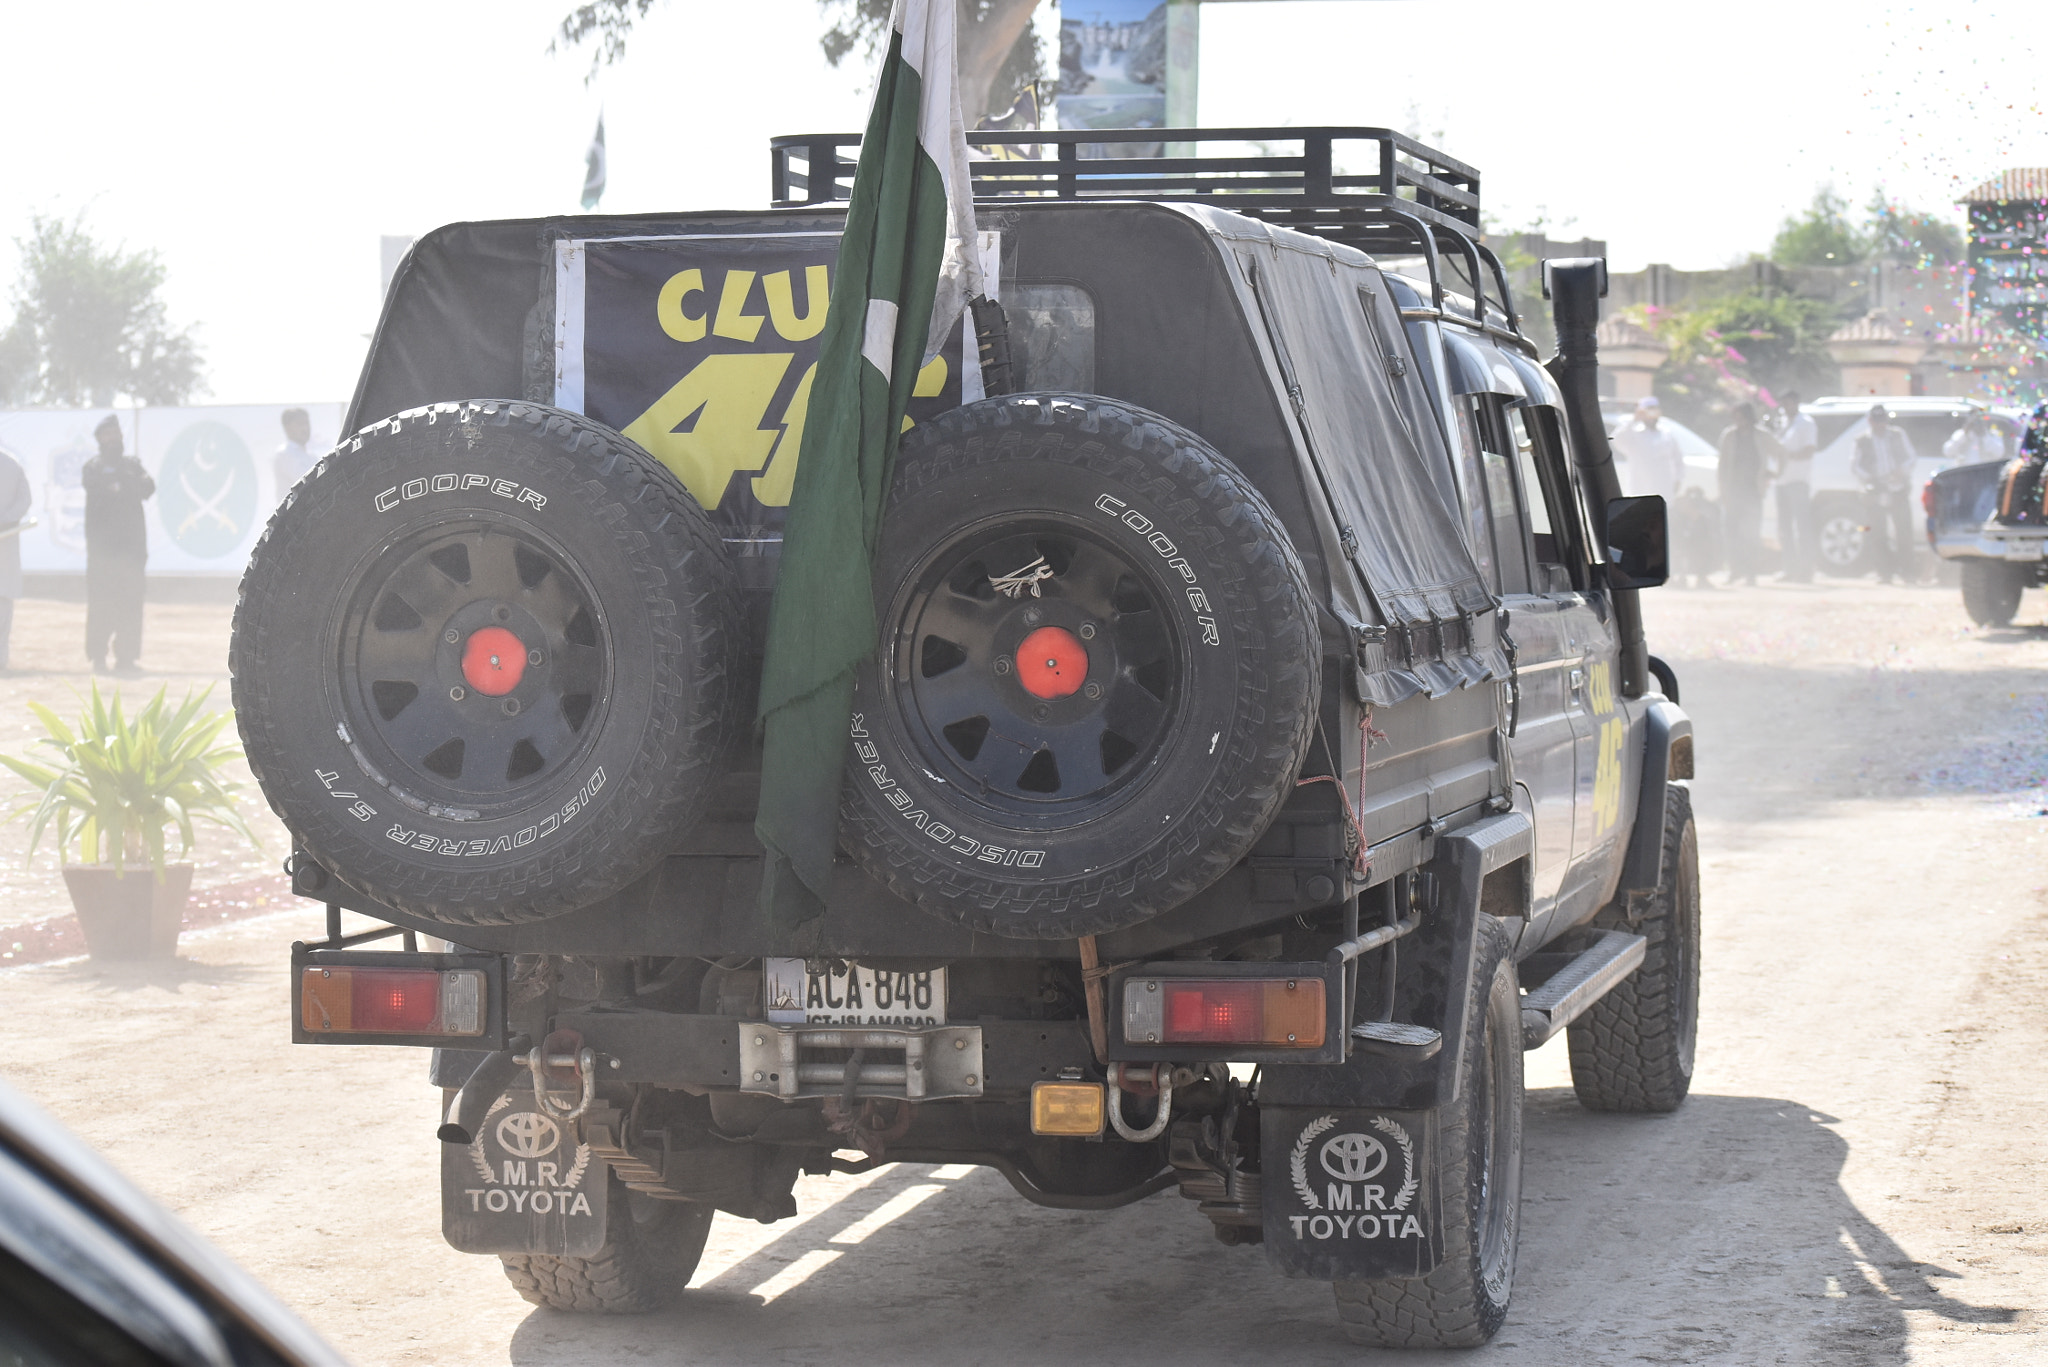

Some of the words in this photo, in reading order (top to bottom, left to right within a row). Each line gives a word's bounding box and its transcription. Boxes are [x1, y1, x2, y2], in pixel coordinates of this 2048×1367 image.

[657, 264, 830, 343] CLU
[374, 473, 547, 513] COOPER
[1094, 493, 1220, 646] COOPER
[314, 767, 378, 822] S/T
[386, 766, 607, 857] DISCOVERER
[850, 712, 1046, 868] DISCOVERER
[503, 1160, 560, 1187] M.R
[1327, 1181, 1387, 1211] M.R
[465, 1188, 592, 1217] TOYOTA
[1289, 1213, 1425, 1240] TOYOTA
